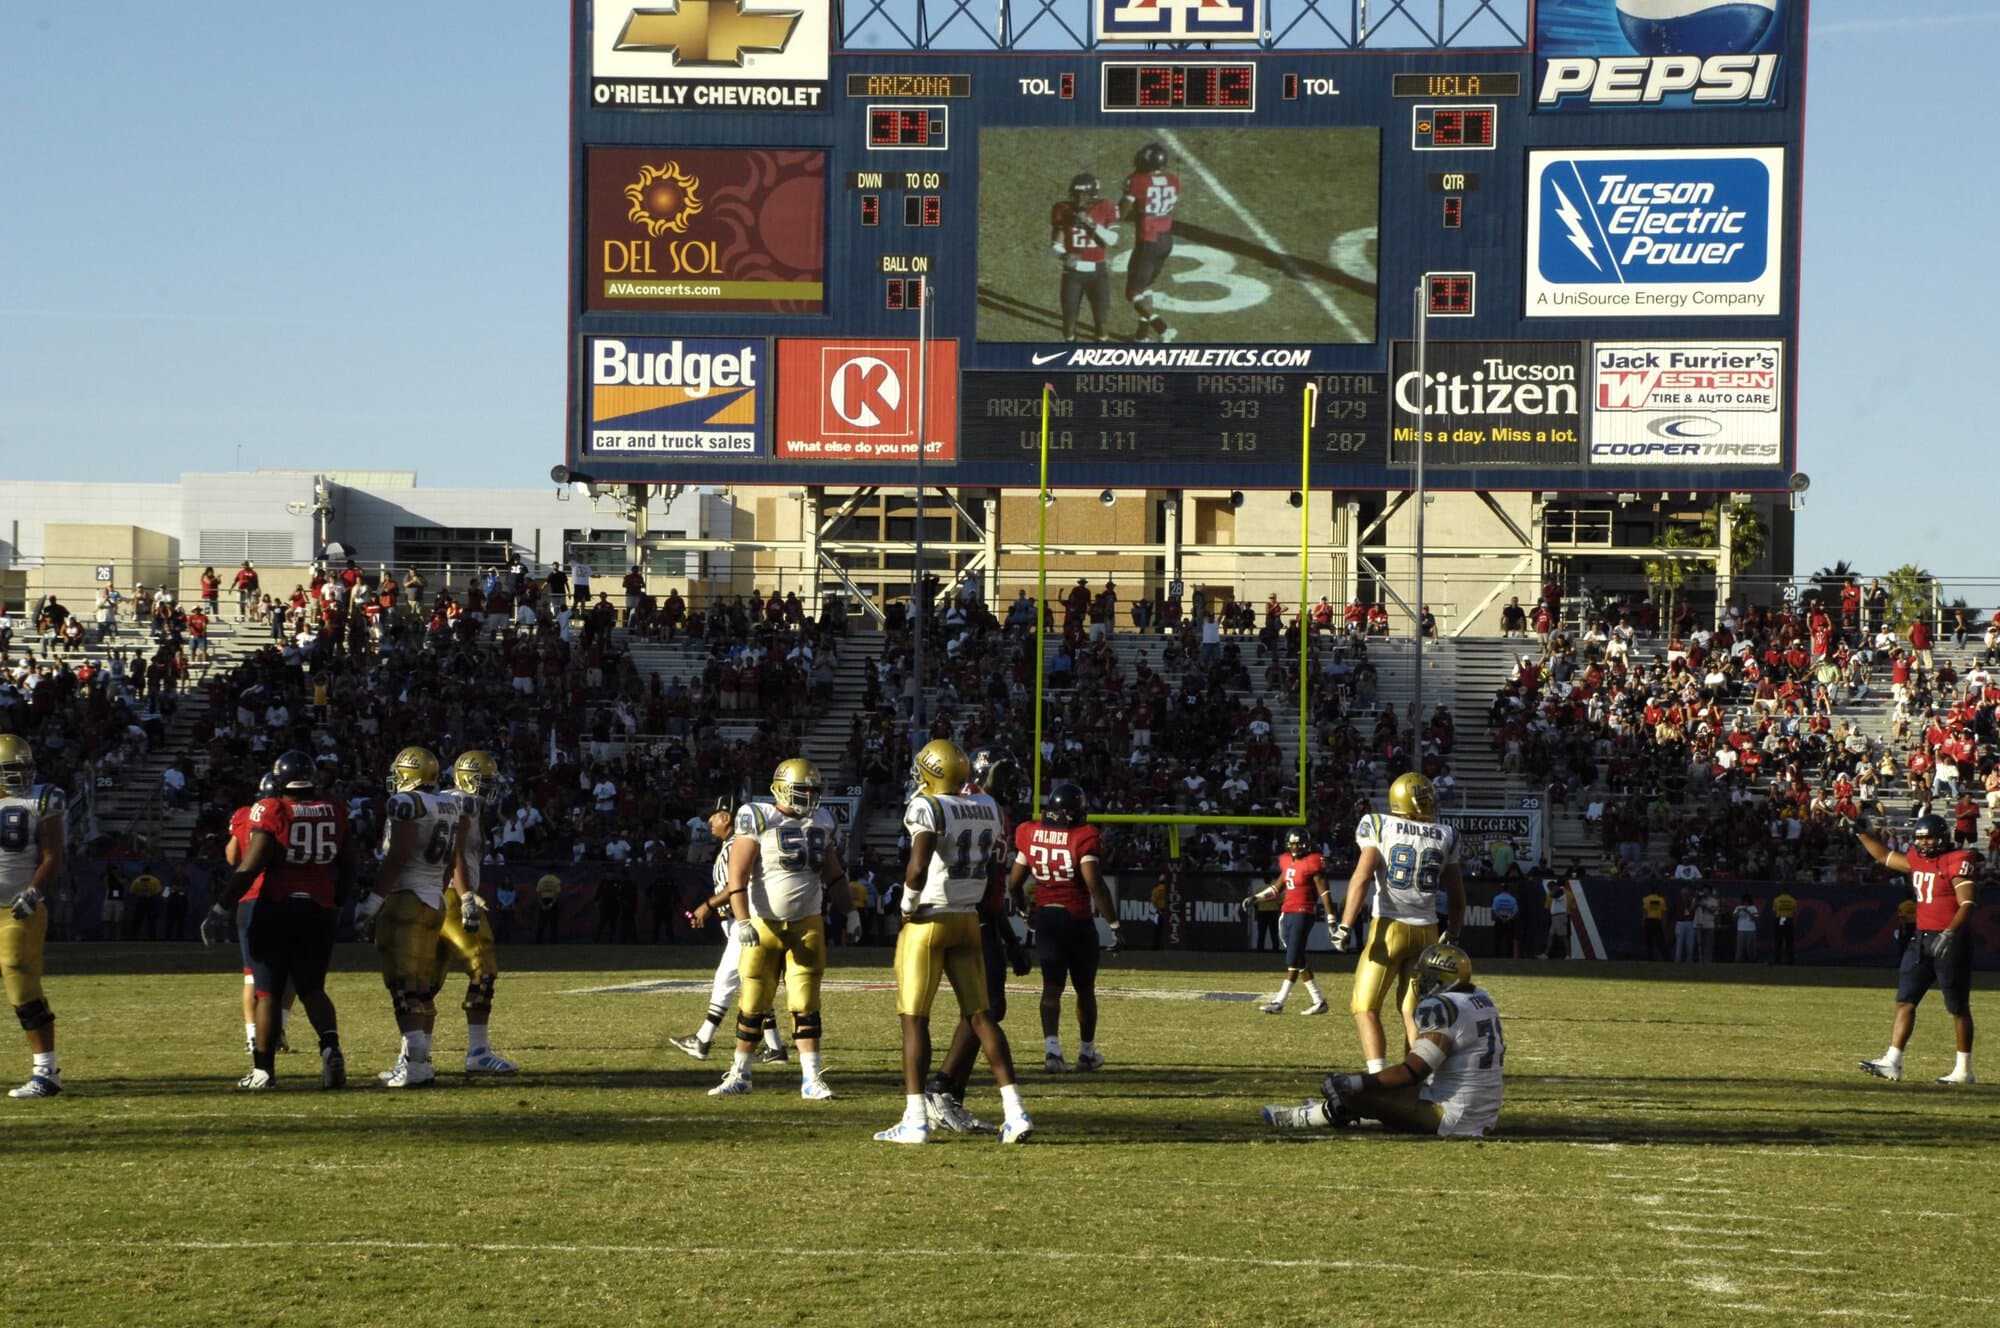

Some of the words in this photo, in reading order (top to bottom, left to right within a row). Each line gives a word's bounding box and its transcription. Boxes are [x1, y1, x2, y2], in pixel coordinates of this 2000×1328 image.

[868, 76, 951, 96] ARIZONA
[1019, 79, 1055, 95] TOL
[1139, 68, 1250, 105] 2:12
[1303, 79, 1340, 95] TOL
[1429, 76, 1480, 95] UCLA
[1538, 54, 1778, 103] PEPSI
[594, 84, 689, 105] O'RIELLY
[693, 86, 821, 106] CHEVROLET
[871, 111, 928, 144] 34
[1434, 111, 1492, 144] 27
[858, 173, 882, 188] DWN
[906, 173, 920, 189] TO
[923, 173, 940, 189] GO
[1443, 174, 1464, 190] QTR
[1597, 175, 1715, 205] Tucson
[863, 198, 878, 223] 4
[1445, 198, 1461, 225] 4
[1608, 206, 1746, 234] Electric
[604, 240, 656, 273] DEL
[669, 240, 724, 274] SOL
[1621, 237, 1744, 265] Power
[883, 257, 908, 271] BALL
[911, 257, 927, 271] ON
[609, 284, 720, 296] AVAconcerts.com
[1432, 279, 1470, 311] 25
[1537, 293, 1549, 305] A
[1553, 292, 1630, 305] UniSource
[1635, 292, 1688, 307] Energy
[1692, 291, 1765, 307] Company
[1067, 349, 1311, 367] ARIZONAATHLETICS.COM
[1601, 353, 1660, 369] Jack
[1670, 353, 1774, 369] Furrier's
[593, 340, 756, 398] Budget
[1484, 359, 1575, 381] Tucson
[843, 363, 890, 422] K
[1076, 374, 1165, 393] RUSHING
[1197, 375, 1285, 394] PASSING
[1315, 375, 1377, 394] TOTAL
[1395, 371, 1578, 415] Citizen
[1600, 372, 1774, 407] WESTERN
[987, 399, 1073, 417] ARIZONA
[1100, 399, 1136, 418] 136
[1220, 399, 1259, 419] 343
[1327, 400, 1367, 419] 479
[1652, 394, 1680, 403] TIRE
[1684, 394, 1693, 403] &
[1698, 394, 1732, 404] AUTO
[1736, 394, 1770, 404] CARE
[596, 436, 621, 448] car
[627, 434, 656, 448] and
[662, 434, 703, 448] truck
[709, 434, 751, 449] sales
[1100, 431, 1135, 450] 111
[1326, 432, 1366, 451] 287
[1394, 428, 1433, 441] Miss
[1437, 431, 1448, 442] a
[1452, 429, 1486, 444] day.
[1491, 428, 1531, 441] Miss
[1535, 431, 1546, 442] a
[1551, 429, 1577, 442] lot.
[787, 441, 821, 453] What
[824, 441, 851, 453] else
[855, 442, 872, 453] do
[875, 443, 898, 455] you
[901, 442, 943, 453] ned?
[1592, 443, 1700, 456] COOPER
[97, 567, 110, 580] 26
[1171, 582, 1182, 595] 28
[1783, 586, 1796, 600] 29
[97, 777, 113, 787] 26
[847, 786, 862, 795] 28
[1522, 799, 1539, 809] 29
[1033, 829, 1068, 845] PALMER
[1396, 822, 1442, 840] PAULSEN
[286, 821, 338, 864] 96
[776, 827, 825, 872] 58
[1030, 845, 1074, 881] 33
[1286, 868, 1296, 890] 5
[1913, 871, 1935, 904] 97
[1195, 901, 1241, 922] MILK
